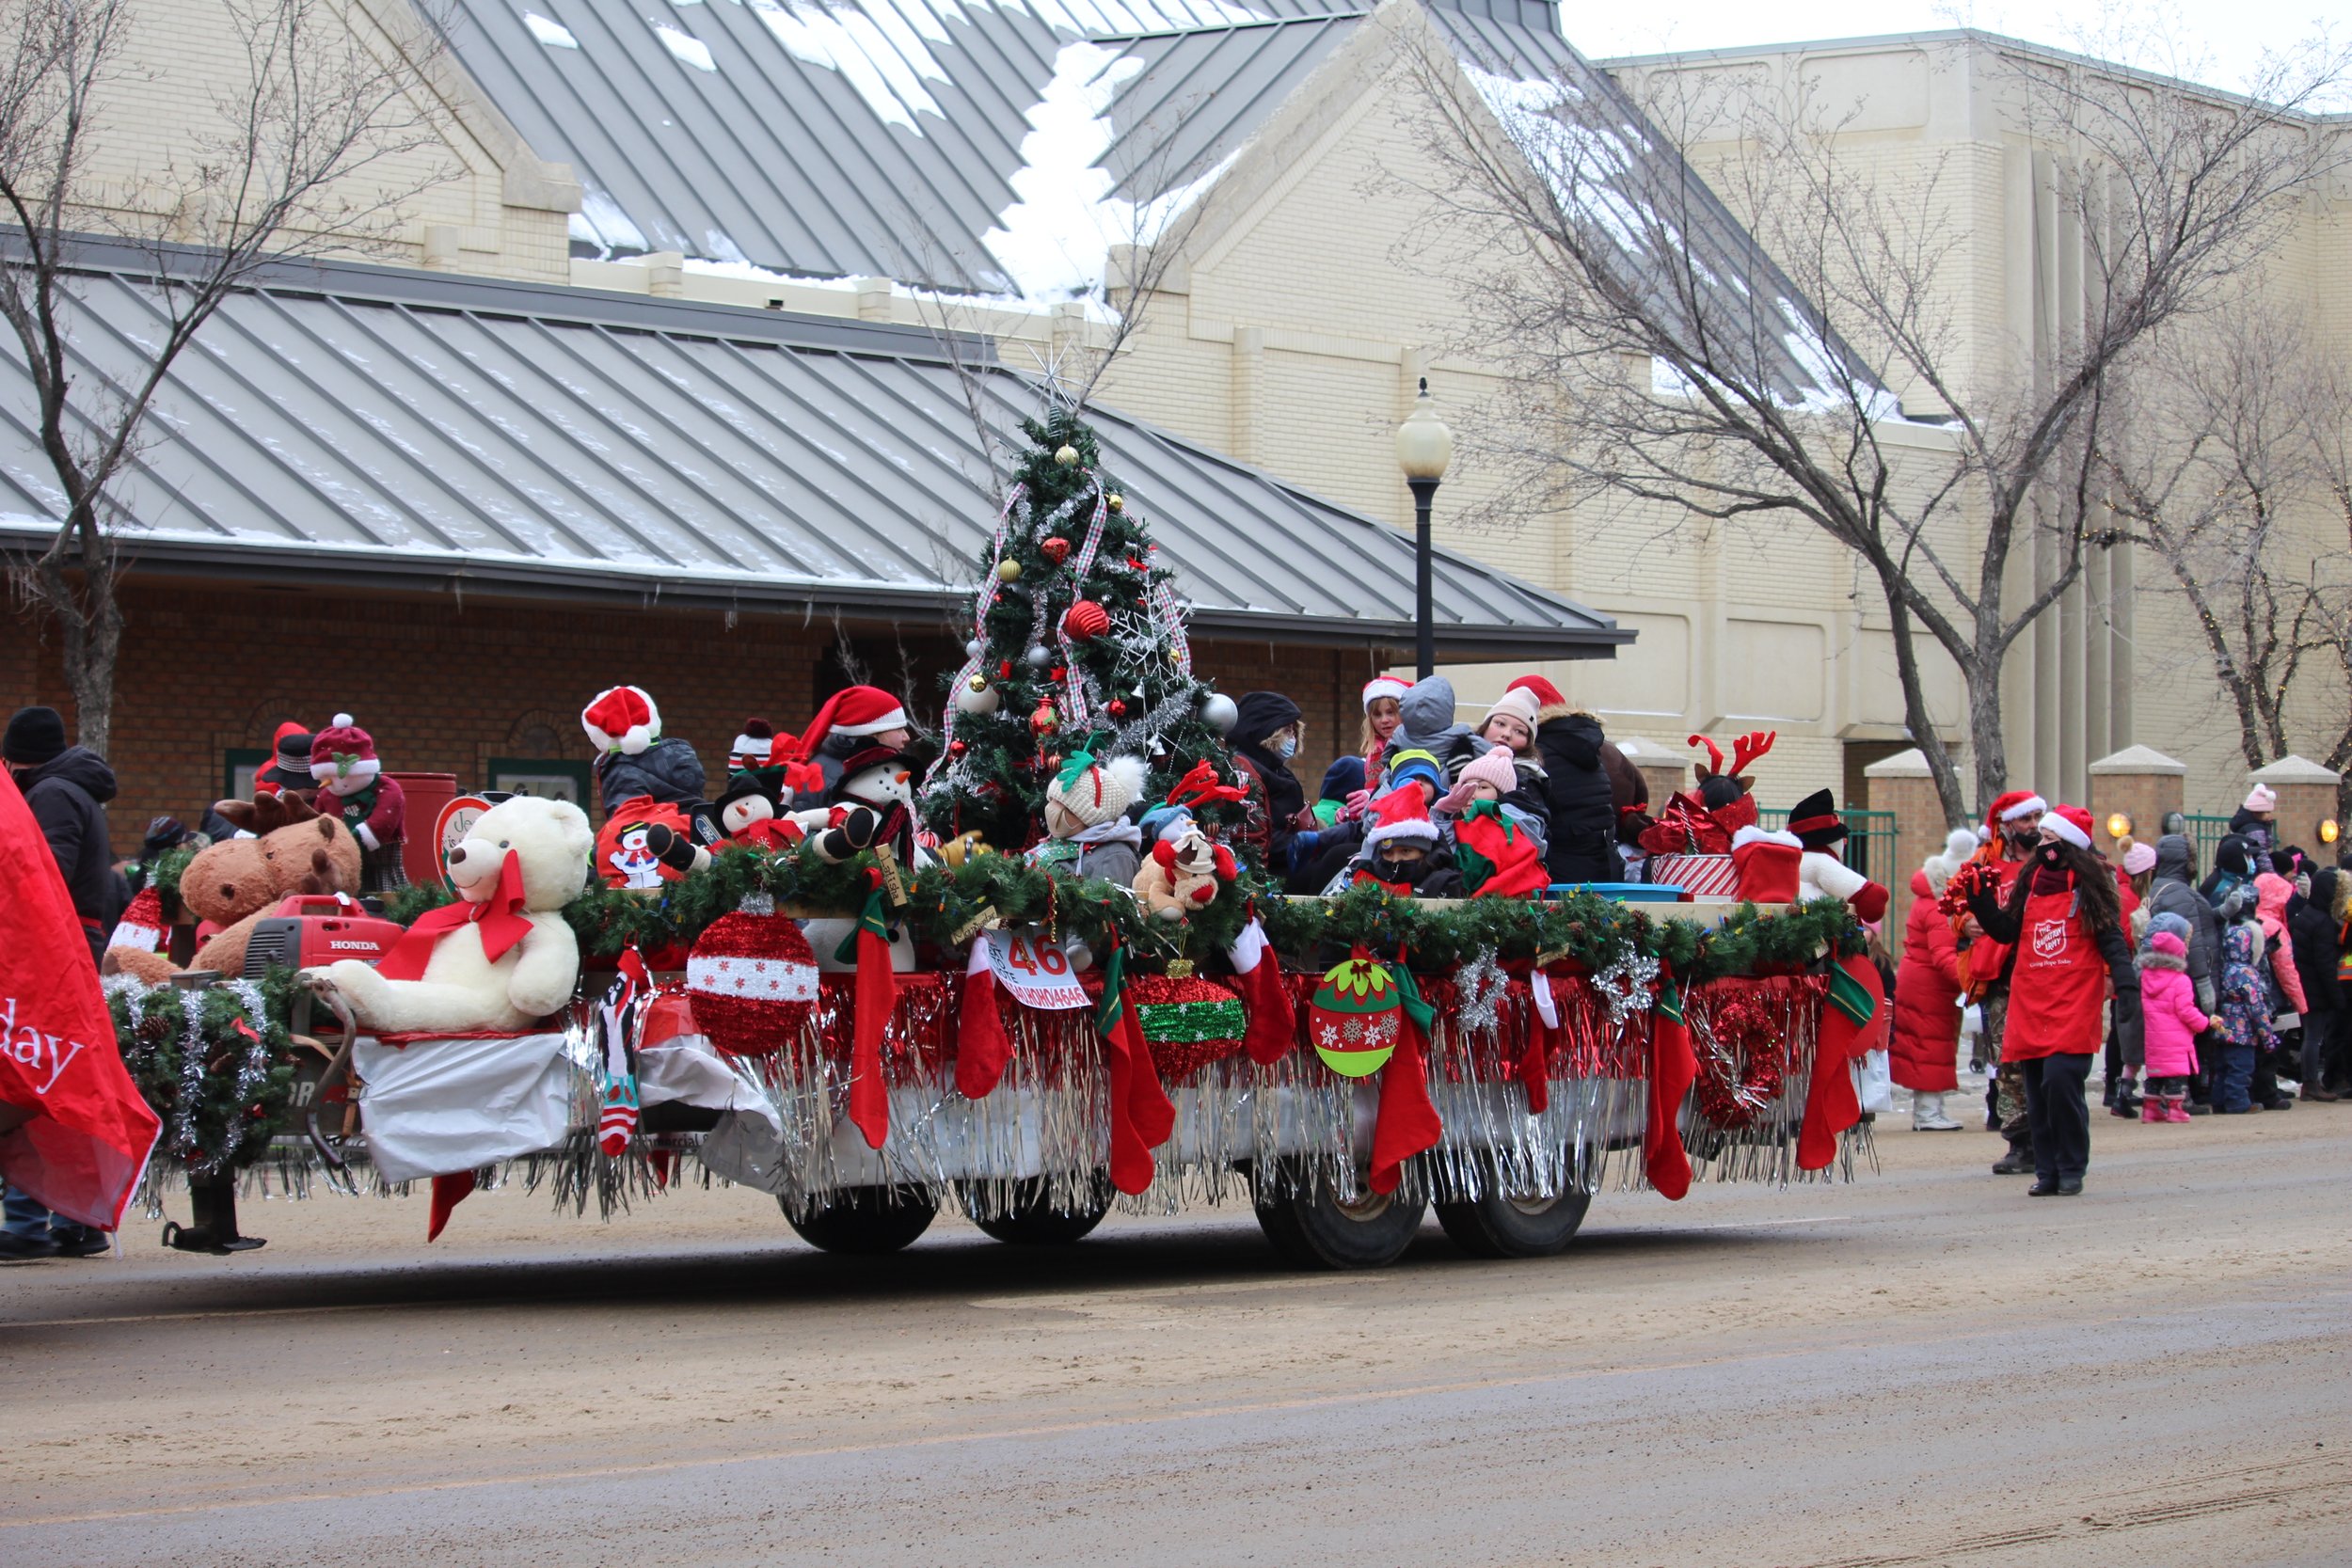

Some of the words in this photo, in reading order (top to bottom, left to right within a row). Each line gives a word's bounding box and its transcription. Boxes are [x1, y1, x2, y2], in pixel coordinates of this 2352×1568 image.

[880, 854, 900, 900] Latisha
[329, 941, 380, 951] HONDA
[1008, 934, 1068, 976] 46
